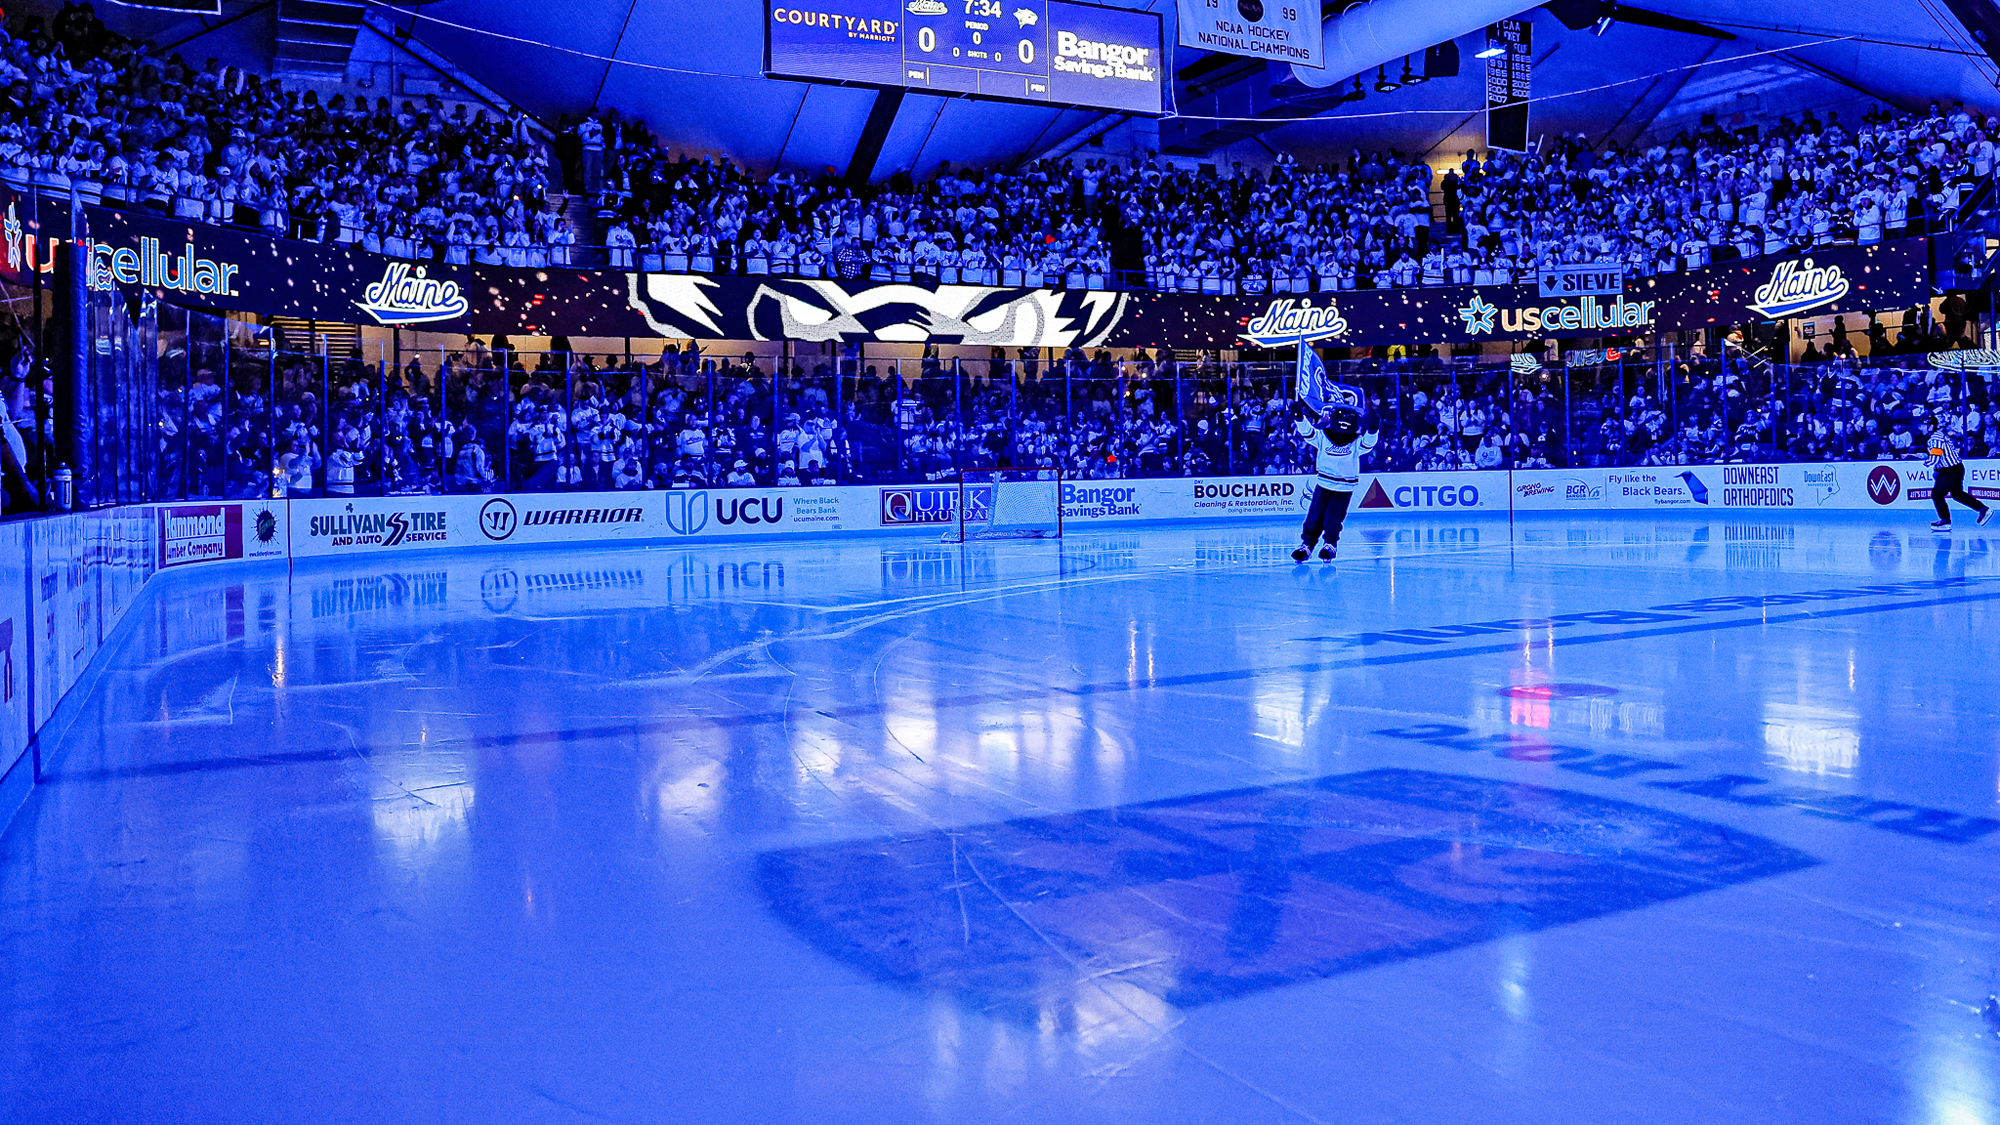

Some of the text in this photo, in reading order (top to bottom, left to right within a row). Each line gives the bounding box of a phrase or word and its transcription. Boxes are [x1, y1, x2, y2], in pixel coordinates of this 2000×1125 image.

[964, 0, 1002, 18] 7:34
[1282, 7, 1296, 21] 99
[774, 8, 896, 35] COURTYARD
[964, 20, 989, 31] PERIOD
[859, 33, 896, 42] MARRIOTT
[918, 27, 937, 53] 0
[972, 31, 982, 45] 0
[1216, 20, 1290, 42] NCAA HOCKEY
[952, 46, 961, 57] 0
[967, 50, 988, 59] SHOTS
[1018, 39, 1035, 64] 0
[1057, 30, 1149, 66] Bangor
[1198, 31, 1310, 60] NATIONAL CHAMPIONS
[994, 51, 1002, 63] 0
[908, 70, 925, 80] PEN
[1054, 55, 1154, 82] Savings Bank
[1030, 83, 1046, 93] PEN
[365, 262, 468, 310] Maine
[1563, 273, 1620, 292] SIEVE
[1755, 258, 1849, 304] Maine
[1247, 298, 1348, 335] Maine
[1501, 295, 1655, 332] uscellular
[1608, 475, 1622, 484] Fly
[1642, 474, 1657, 482] the
[1724, 466, 1779, 485] DOWNEAST
[1061, 483, 1136, 507] Bangor
[1194, 483, 1295, 498] BOUCHARD
[1394, 485, 1479, 507] CITGO
[1524, 486, 1555, 498] BREWING
[1566, 485, 1586, 495] BGR
[1622, 486, 1686, 496] Black Bears.
[1724, 488, 1794, 506] ORTHOPEDICS
[716, 497, 783, 525] UCU
[796, 507, 816, 515] Bears
[886, 490, 988, 520] QUIRK
[1057, 503, 1141, 518] Savings Bank
[1194, 500, 1226, 509] Cleaning
[1235, 499, 1279, 507] Restoration,
[165, 507, 225, 540] Hammond
[310, 512, 447, 536] SULLIVAN TIRE
[523, 508, 643, 526] WARRIOR
[915, 509, 989, 521] HYUNDAI
[332, 532, 447, 546] AND AUTO SERVICE
[188, 541, 223, 557] Company
